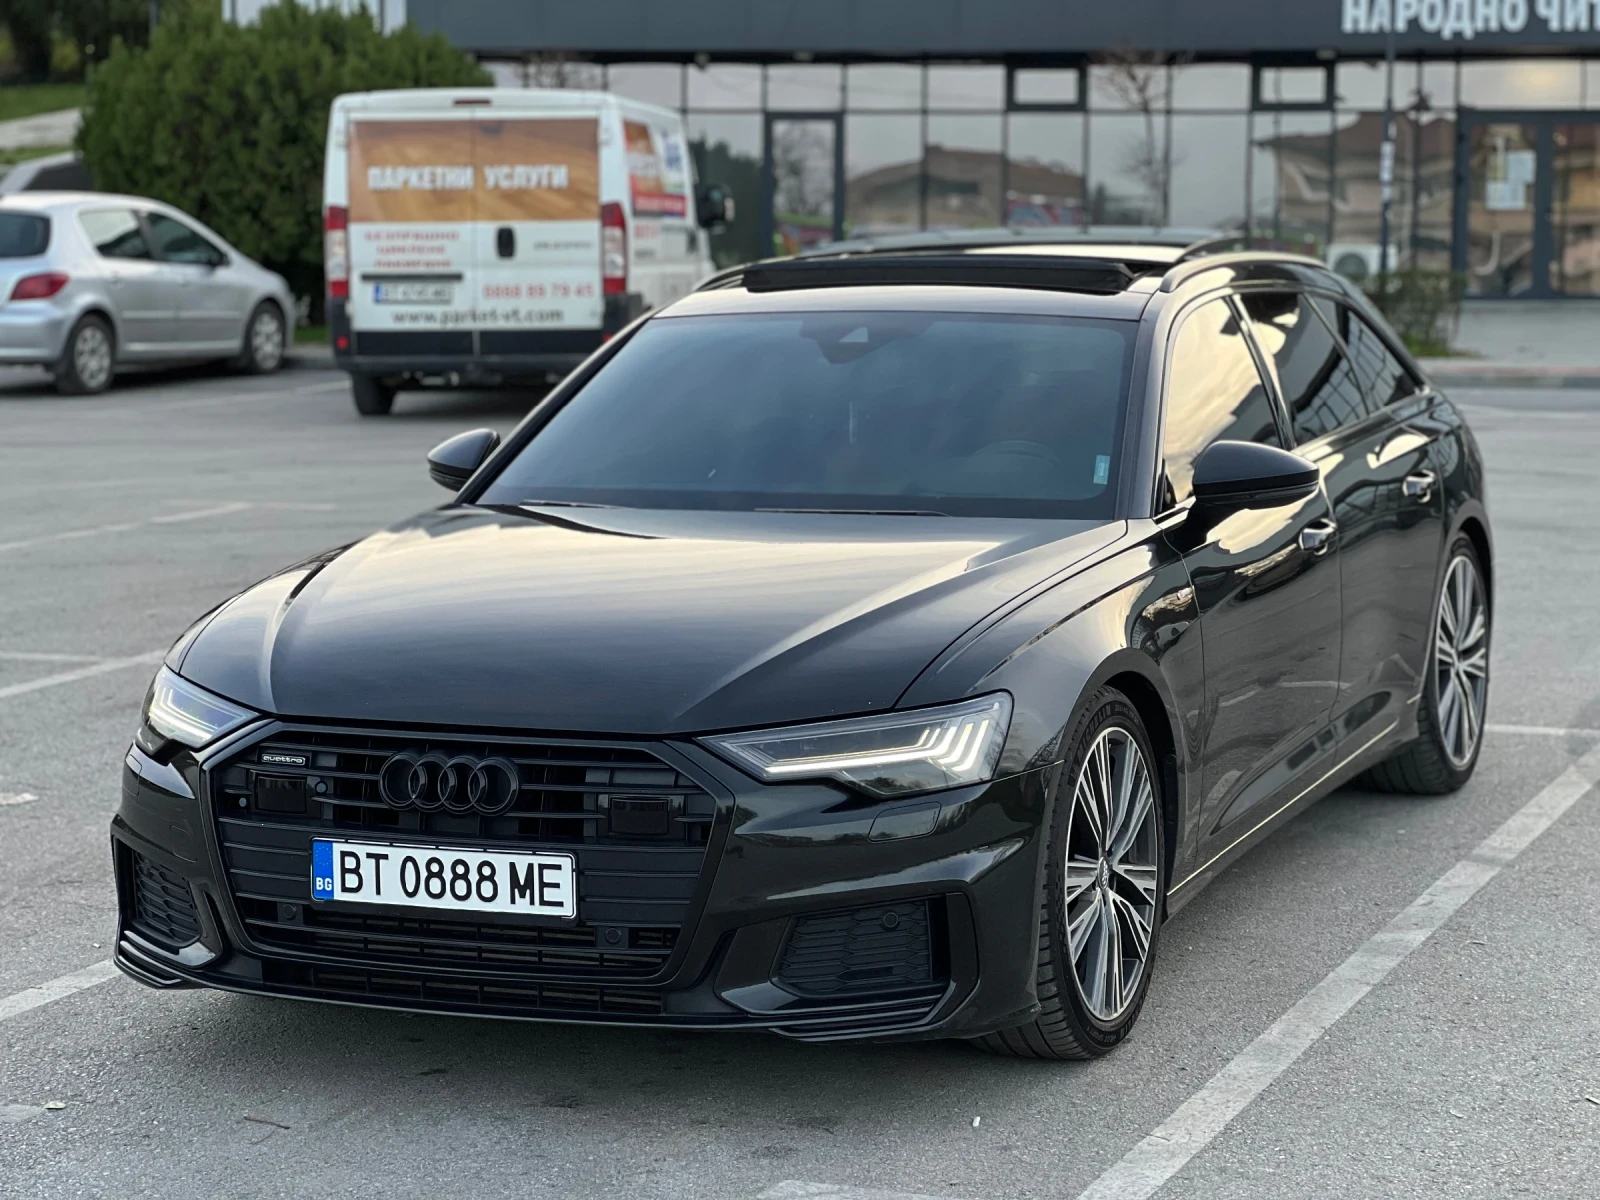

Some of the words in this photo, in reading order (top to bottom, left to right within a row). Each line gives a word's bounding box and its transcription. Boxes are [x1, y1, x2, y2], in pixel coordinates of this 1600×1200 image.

[1341, 0, 1529, 40] НАРОДНО
[367, 164, 475, 190] ПАРКЕТНИ
[483, 163, 569, 190] УСЛУГИ
[263, 755, 303, 765] quattro
[315, 877, 333, 891] BG
[339, 850, 388, 896] BT
[400, 855, 499, 903] 0888
[510, 862, 564, 907] ME
